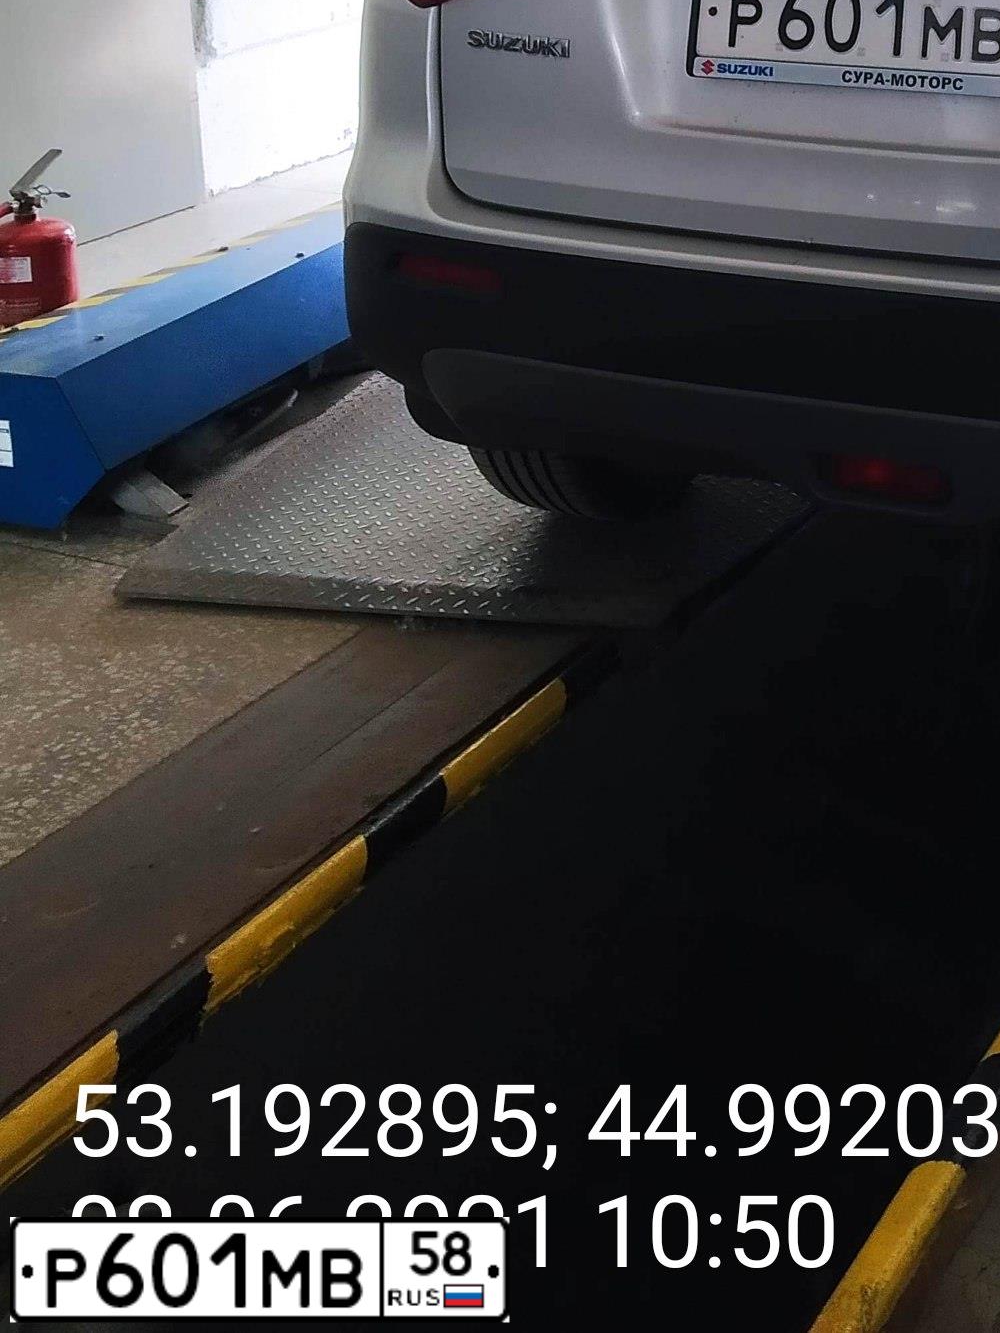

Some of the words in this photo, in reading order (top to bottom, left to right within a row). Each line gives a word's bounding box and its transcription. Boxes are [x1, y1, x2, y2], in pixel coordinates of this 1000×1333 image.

[466, 30, 571, 58] SUZUKI
[716, 63, 774, 78] SUZUKI
[841, 69, 964, 91] СУРА-МОТОРС
